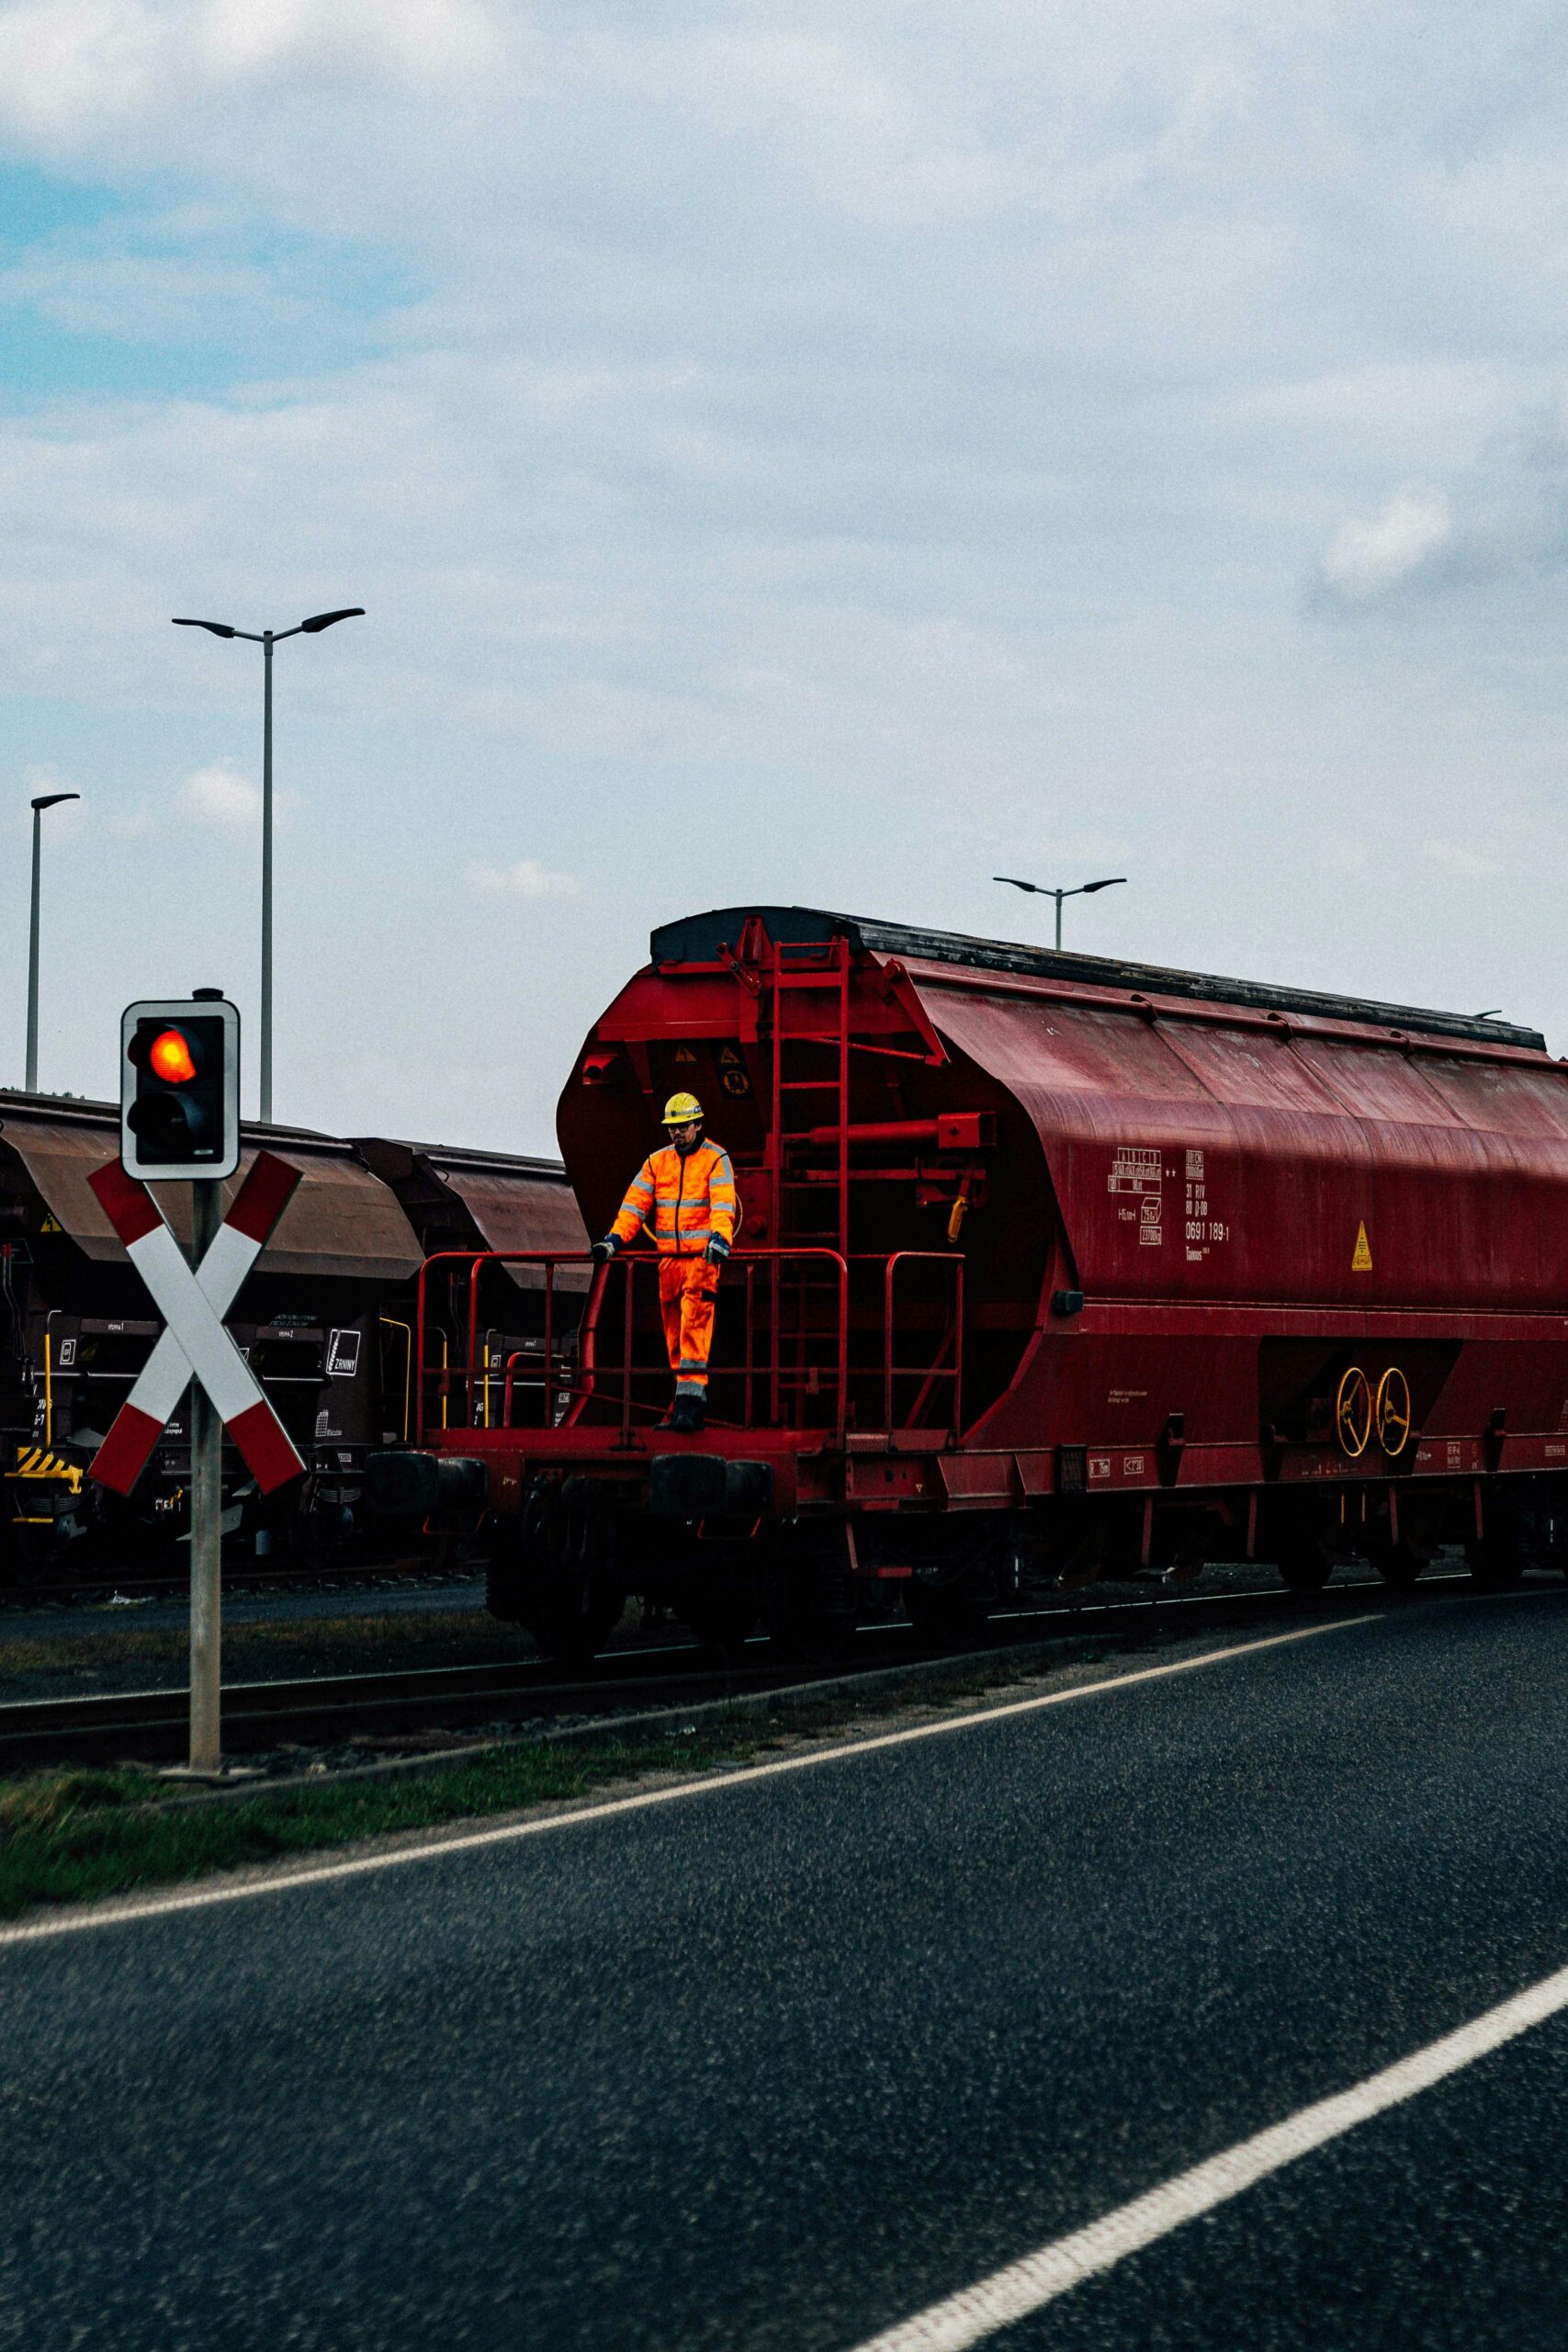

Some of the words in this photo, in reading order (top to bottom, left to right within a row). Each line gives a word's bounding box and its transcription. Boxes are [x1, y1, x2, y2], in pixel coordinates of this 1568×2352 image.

[1186, 1183, 1192, 1198] 31
[1195, 1184, 1205, 1199] RIV
[1186, 1221, 1205, 1240] 0691
[1209, 1221, 1229, 1241] 189-1
[334, 1358, 355, 1371] ZRNINY
